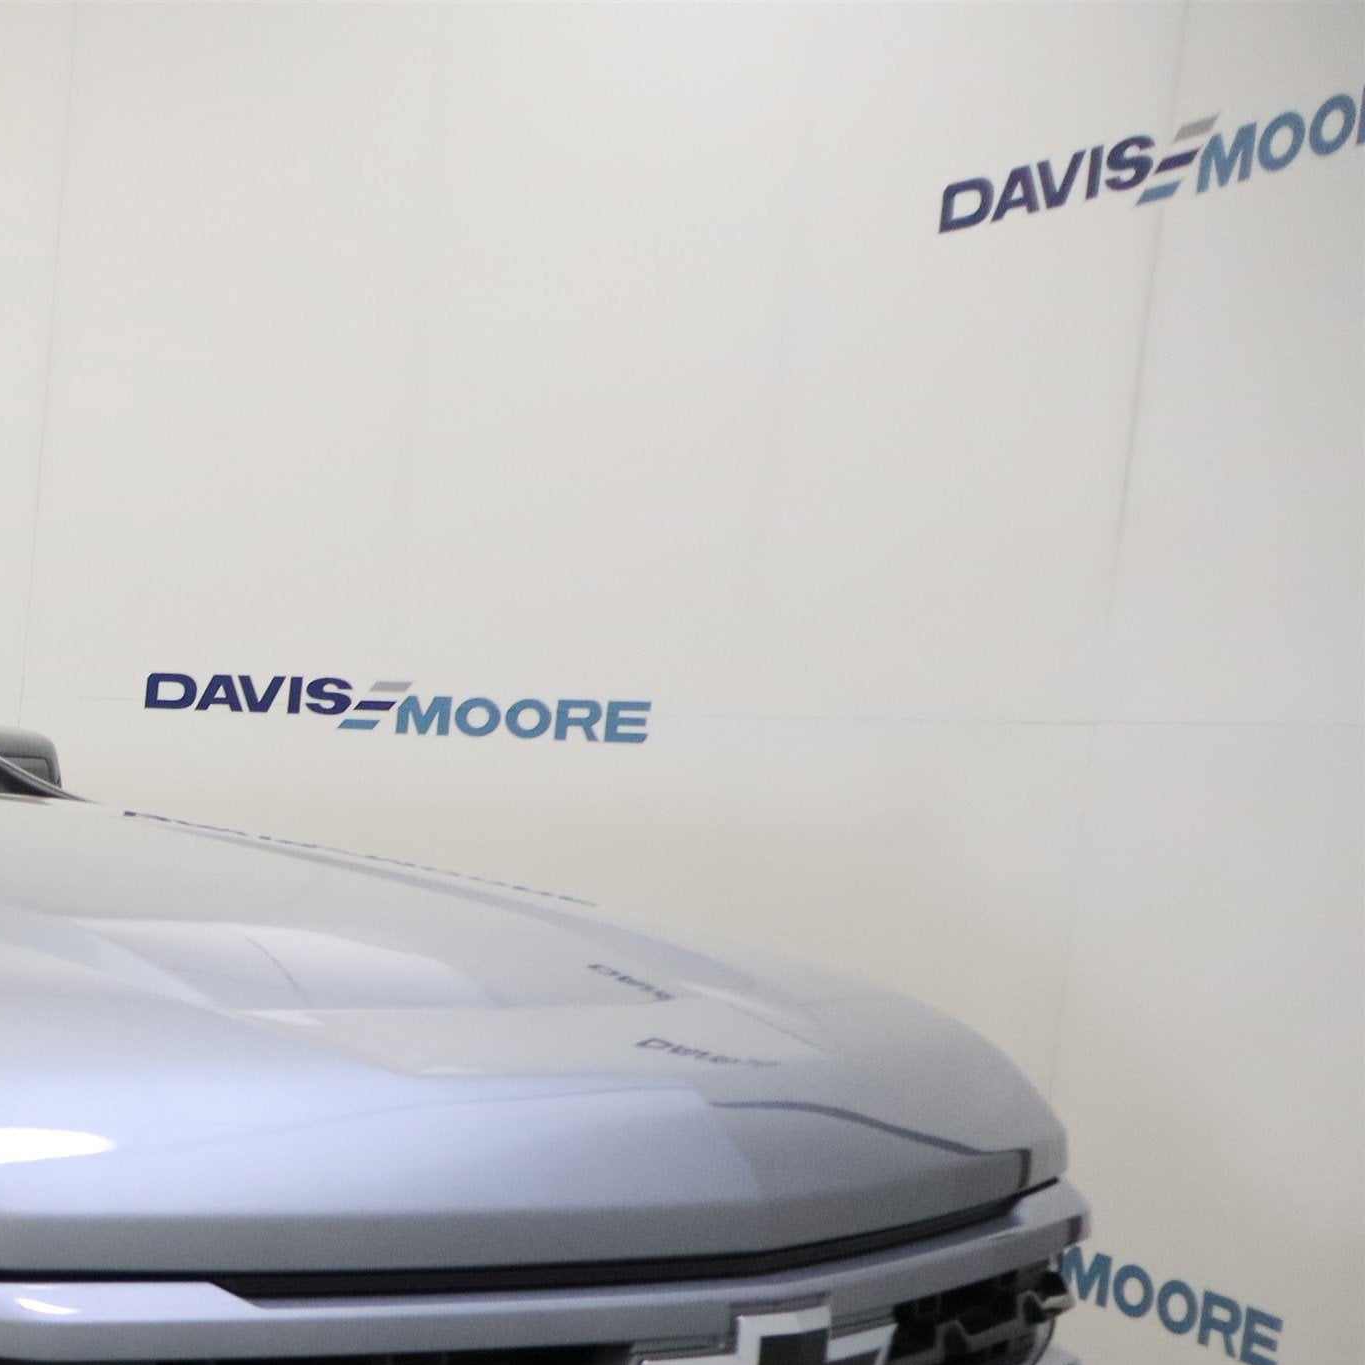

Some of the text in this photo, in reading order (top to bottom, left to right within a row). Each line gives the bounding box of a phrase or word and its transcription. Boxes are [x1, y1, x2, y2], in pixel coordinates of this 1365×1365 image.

[938, 82, 1365, 234] DAVIS MOO
[144, 673, 652, 744] DAVIS MOORE
